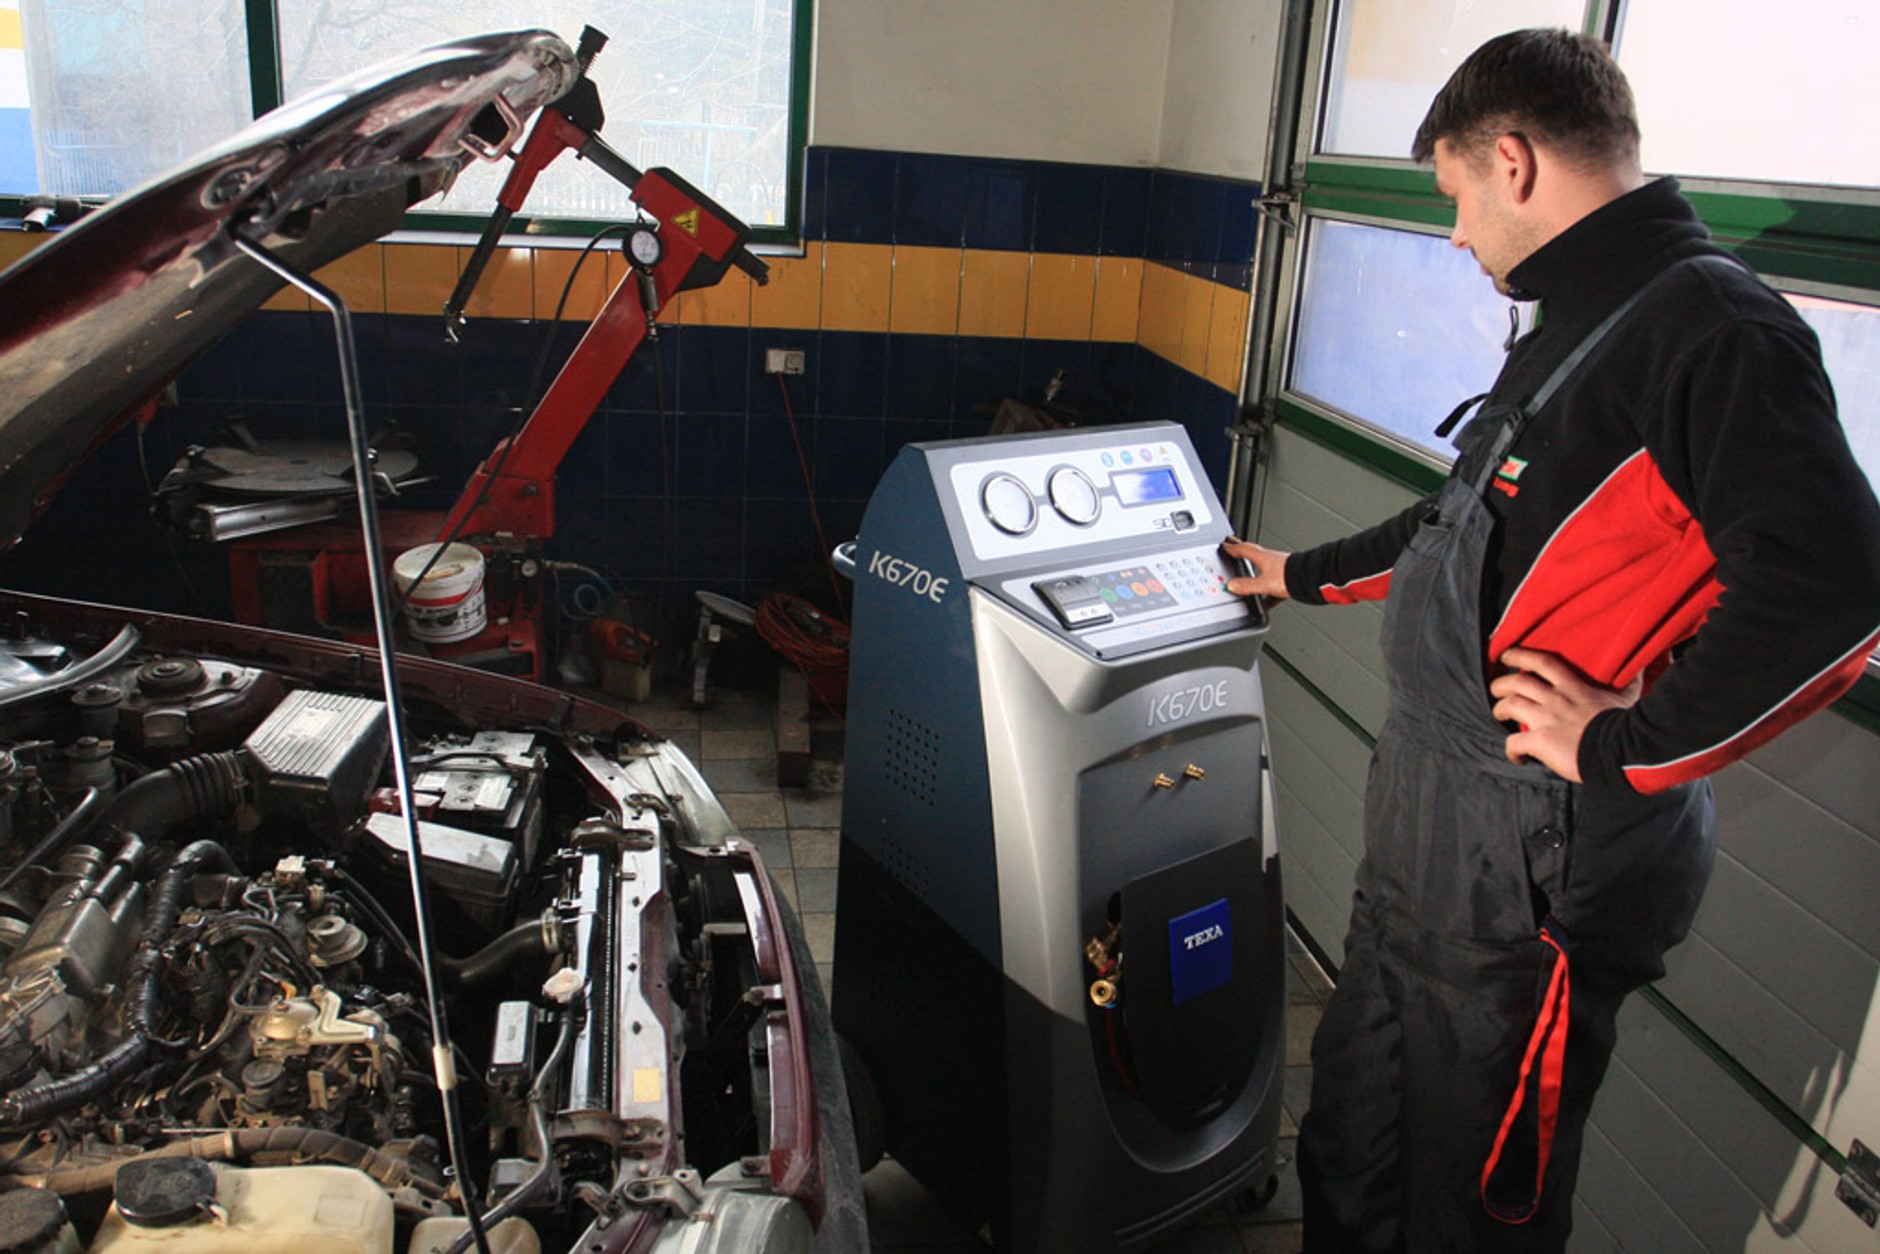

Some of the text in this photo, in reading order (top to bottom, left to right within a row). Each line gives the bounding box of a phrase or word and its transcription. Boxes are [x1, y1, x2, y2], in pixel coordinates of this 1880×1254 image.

[868, 550, 950, 604] K670E
[1146, 679, 1228, 727] K670E
[1183, 924, 1224, 951] TEXA
